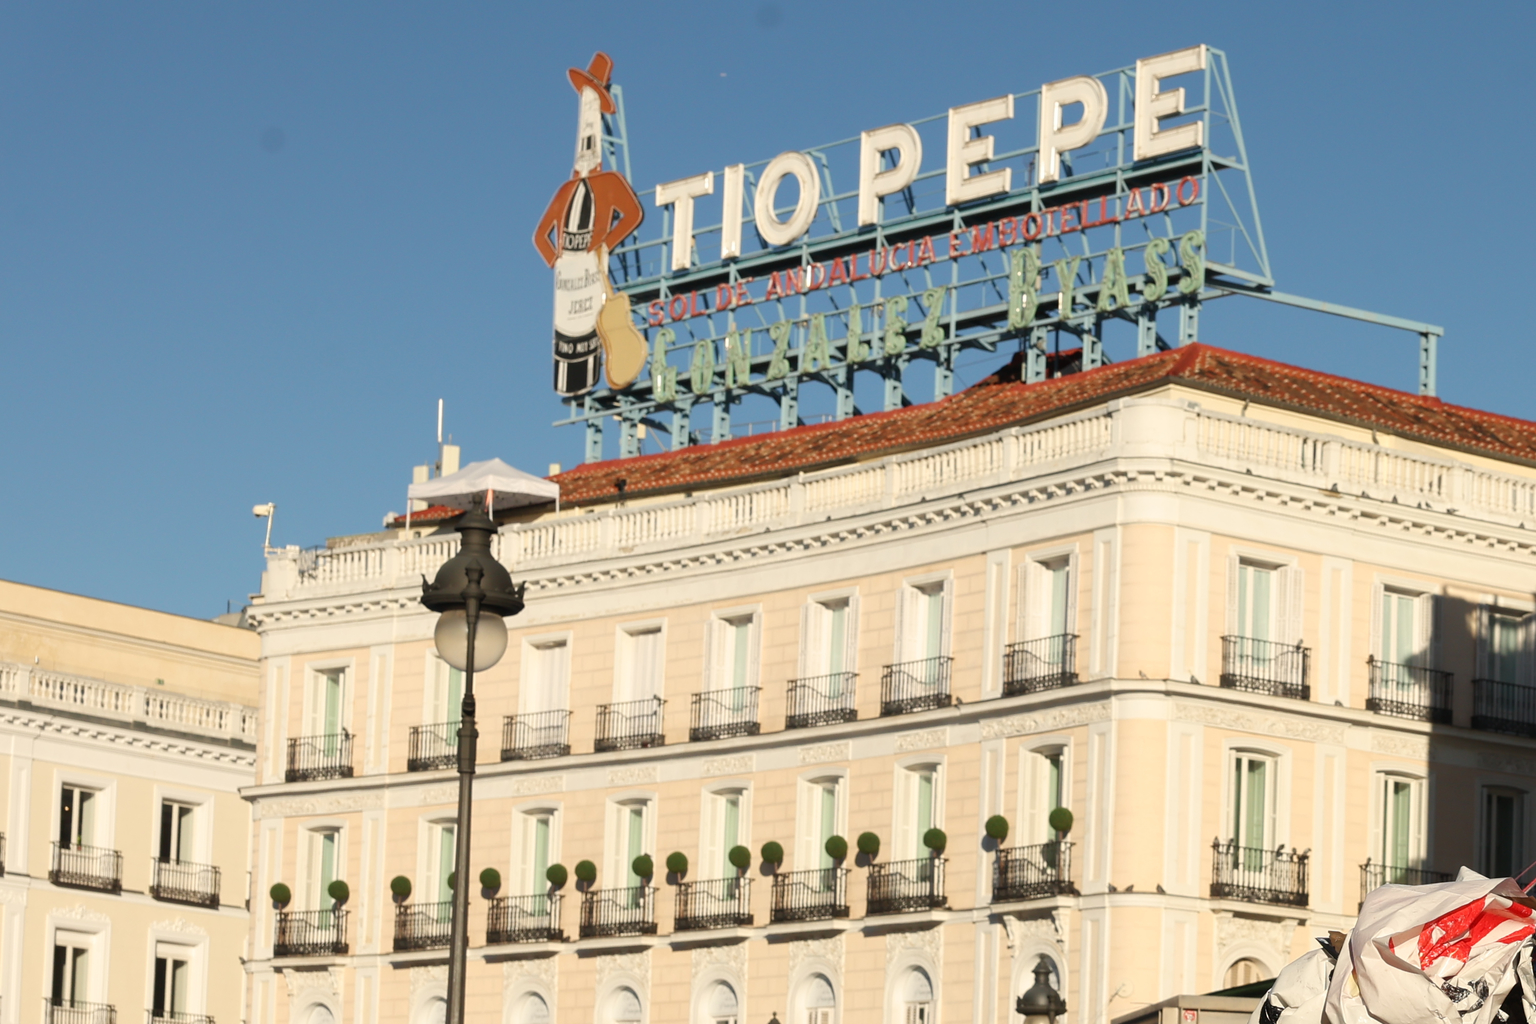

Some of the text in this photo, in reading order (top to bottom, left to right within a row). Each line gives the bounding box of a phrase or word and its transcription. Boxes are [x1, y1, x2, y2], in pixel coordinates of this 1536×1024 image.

[656, 43, 1207, 271] TIO PEPE
[648, 175, 1200, 327] SOL DE ANDALUCIA EMBOTELLADO
[651, 229, 1206, 404] GONZALEZ BYASS
